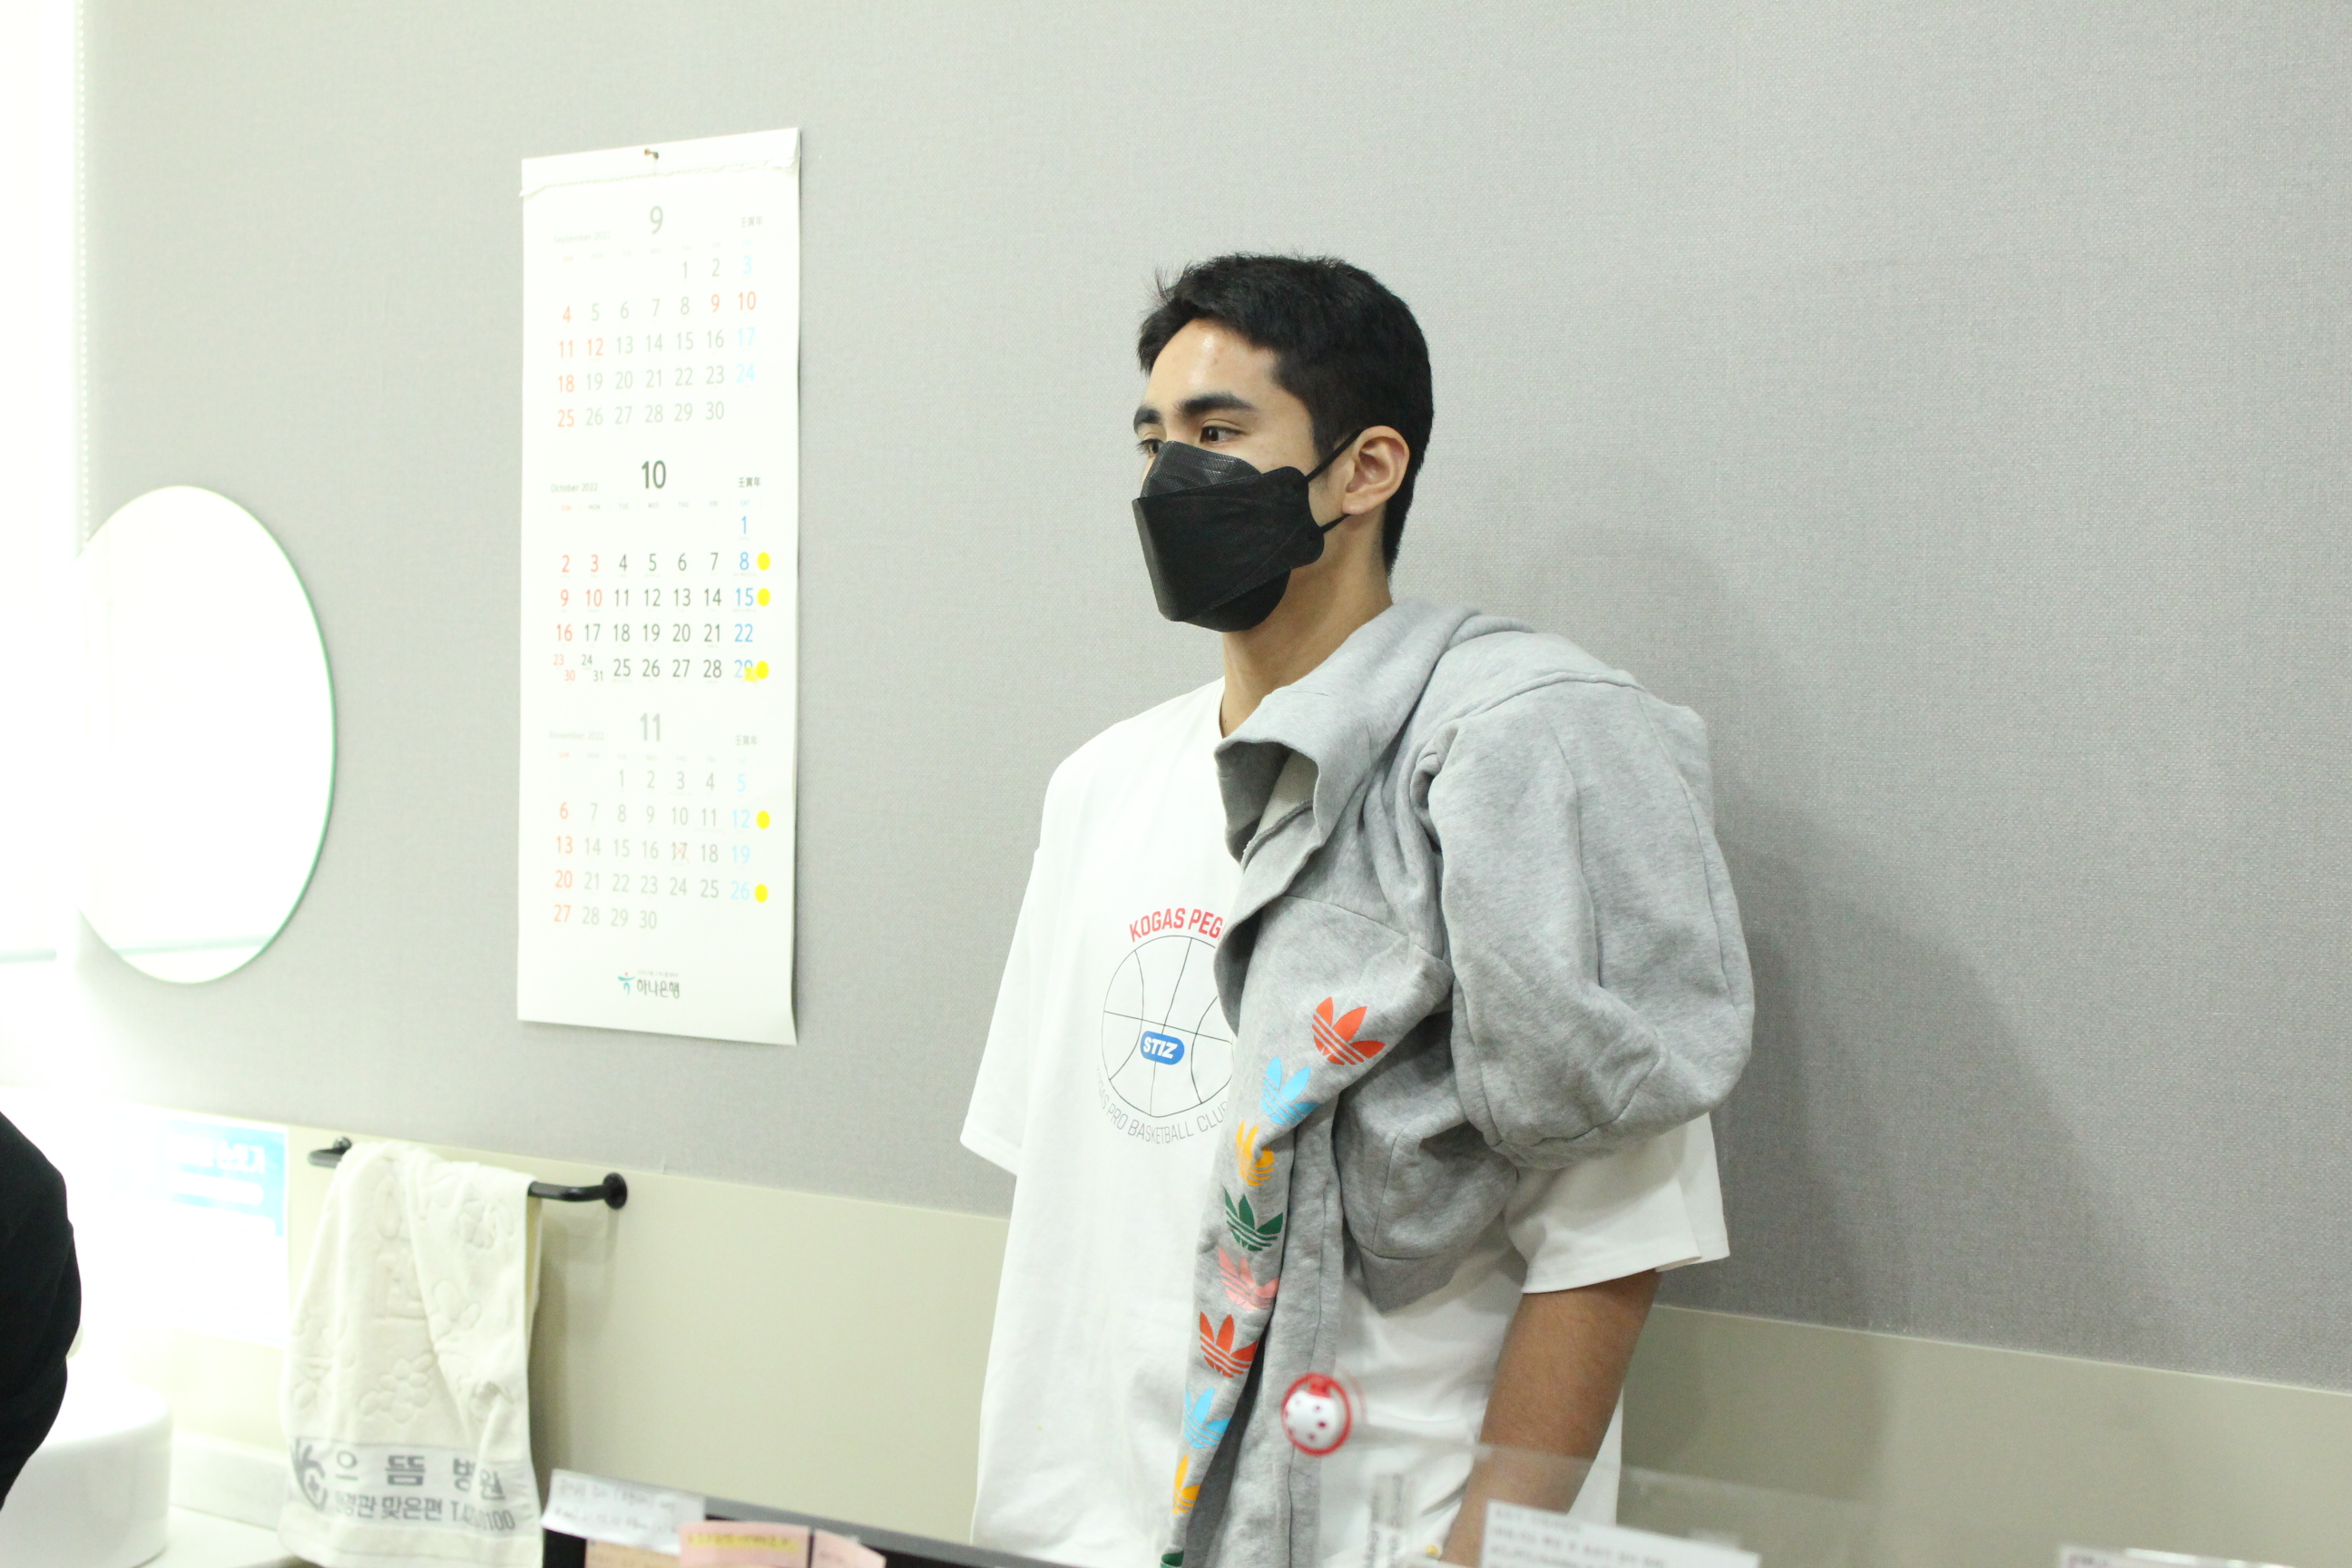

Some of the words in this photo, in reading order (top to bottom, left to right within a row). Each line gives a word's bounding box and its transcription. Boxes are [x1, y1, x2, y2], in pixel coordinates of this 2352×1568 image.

[649, 205, 663, 235] 9
[593, 230, 611, 240] 2022
[681, 260, 688, 279] 1
[711, 257, 720, 278] 2
[742, 255, 752, 275] 3
[562, 305, 572, 323] 4
[591, 302, 600, 322] 5
[620, 300, 630, 320] 6
[652, 298, 661, 318] 7
[680, 296, 691, 316] 8
[710, 294, 720, 313] 9
[738, 290, 757, 311] 10
[559, 339, 573, 358] 11
[586, 338, 604, 357] 12
[615, 335, 633, 355] 13
[646, 333, 663, 353] 14
[676, 330, 694, 351] 15
[707, 329, 724, 348] 16
[737, 327, 756, 347] 17
[557, 374, 575, 393] 18
[585, 371, 603, 392] 19
[614, 370, 633, 390] 20
[645, 368, 662, 388] 21
[674, 367, 693, 387] 22
[705, 365, 725, 385] 23
[736, 363, 756, 383] 24
[557, 408, 575, 428] 25
[584, 407, 603, 426] 26
[614, 405, 632, 426] 27
[644, 404, 664, 424] 28
[673, 402, 693, 423] 29
[705, 400, 725, 421] 30
[641, 459, 667, 490] 10
[551, 483, 580, 494] October
[582, 482, 598, 492] 2022
[709, 500, 719, 508] FRI
[740, 499, 750, 507] SAT
[740, 515, 747, 534] 1
[561, 554, 571, 573] 2
[590, 554, 600, 573] 3
[618, 554, 628, 572] 4
[648, 553, 657, 573] 5
[678, 553, 687, 572] 6
[710, 552, 719, 571] 7
[739, 551, 750, 571] 8
[560, 589, 570, 607] 9
[585, 588, 603, 608] 10
[614, 588, 629, 607] 11
[643, 588, 661, 607] 12
[673, 587, 691, 607] 13
[704, 588, 722, 606] 14
[735, 587, 754, 607] 15
[556, 623, 573, 642] 16
[584, 622, 601, 642] 17
[613, 623, 631, 642] 18
[642, 622, 661, 642] 19
[672, 622, 691, 642] 20
[703, 623, 720, 642] 21
[734, 622, 754, 642] 22
[553, 653, 565, 667] 23
[581, 653, 593, 667] 24
[612, 658, 632, 678] 25
[642, 658, 661, 678] 26
[671, 659, 691, 678] 27
[703, 659, 722, 679] 28
[564, 669, 576, 682] 30
[593, 669, 603, 682] 31
[549, 730, 585, 740] November
[587, 731, 604, 741] 2022
[640, 712, 662, 741] 11
[618, 769, 625, 789] 1
[646, 769, 655, 789] 2
[676, 770, 685, 790] 3
[705, 772, 716, 791] 4
[737, 772, 747, 793] 5
[559, 801, 569, 820] 6
[589, 802, 598, 821] 7
[616, 803, 627, 824] 8
[645, 805, 655, 824] 9
[671, 806, 689, 827] 10
[701, 808, 717, 828] 11
[731, 808, 750, 828] 12
[555, 835, 573, 855] 13
[583, 837, 602, 856] 14
[612, 838, 631, 858] 15
[642, 840, 659, 860] 16
[701, 843, 719, 864] 18
[731, 845, 751, 864] 19
[554, 869, 573, 889] 20
[583, 871, 600, 890] 21
[611, 873, 630, 893] 22
[640, 875, 658, 895] 23
[669, 877, 688, 897] 24
[700, 878, 720, 899] 25
[730, 880, 750, 901] 26
[553, 903, 572, 923] 27
[582, 906, 600, 926] 28
[610, 907, 629, 927] 29
[639, 909, 658, 930] 30
[1130, 907, 1186, 942] KOGAS
[1188, 908, 1227, 941] PEG
[637, 978, 680, 999] 하나은행
[1143, 1036, 1178, 1059] STIZ
[1106, 1102, 1129, 1131] PRO
[1127, 1119, 1194, 1144] BASKETBALL
[381, 1495, 442, 1522] 맞은편
